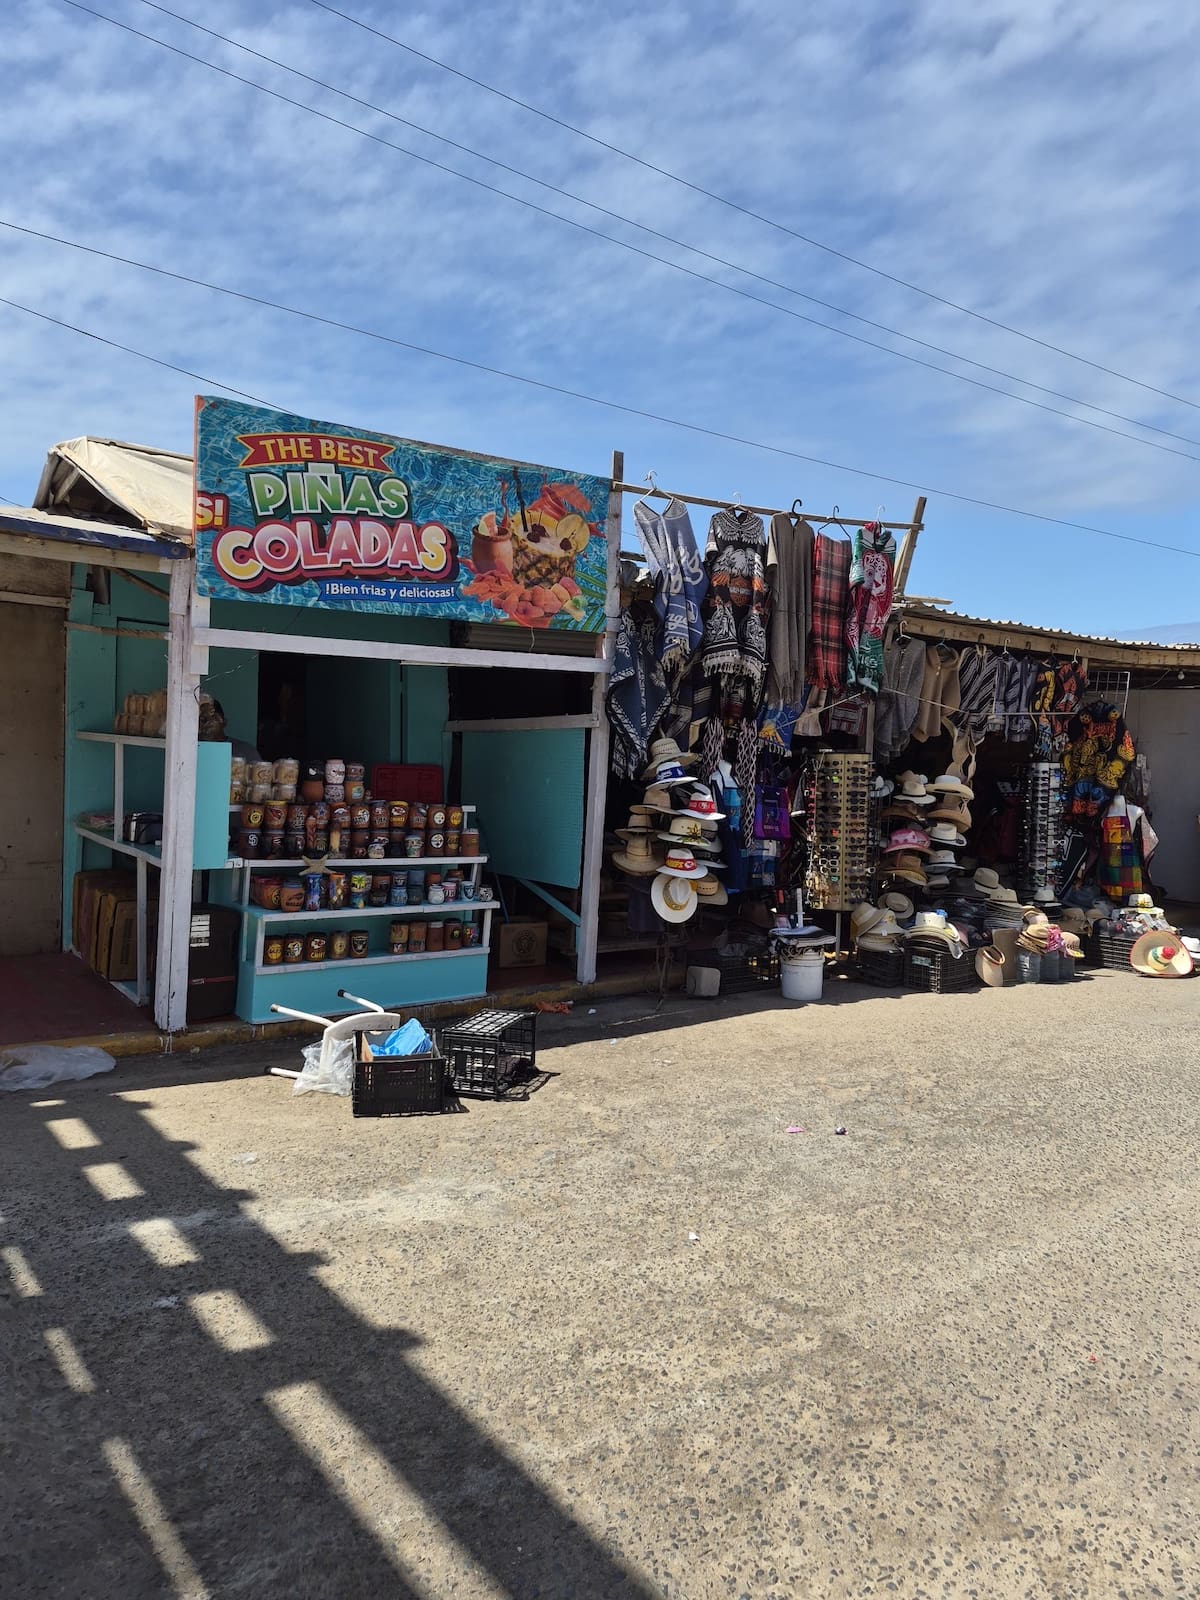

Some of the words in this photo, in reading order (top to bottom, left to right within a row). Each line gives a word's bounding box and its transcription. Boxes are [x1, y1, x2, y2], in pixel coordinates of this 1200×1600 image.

[259, 438, 314, 461] THE
[319, 438, 378, 467] BEST
[249, 462, 410, 519] PIÑAS
[216, 520, 448, 580] COLADAS
[389, 588, 397, 599] y
[399, 586, 455, 598] deliciosas!
